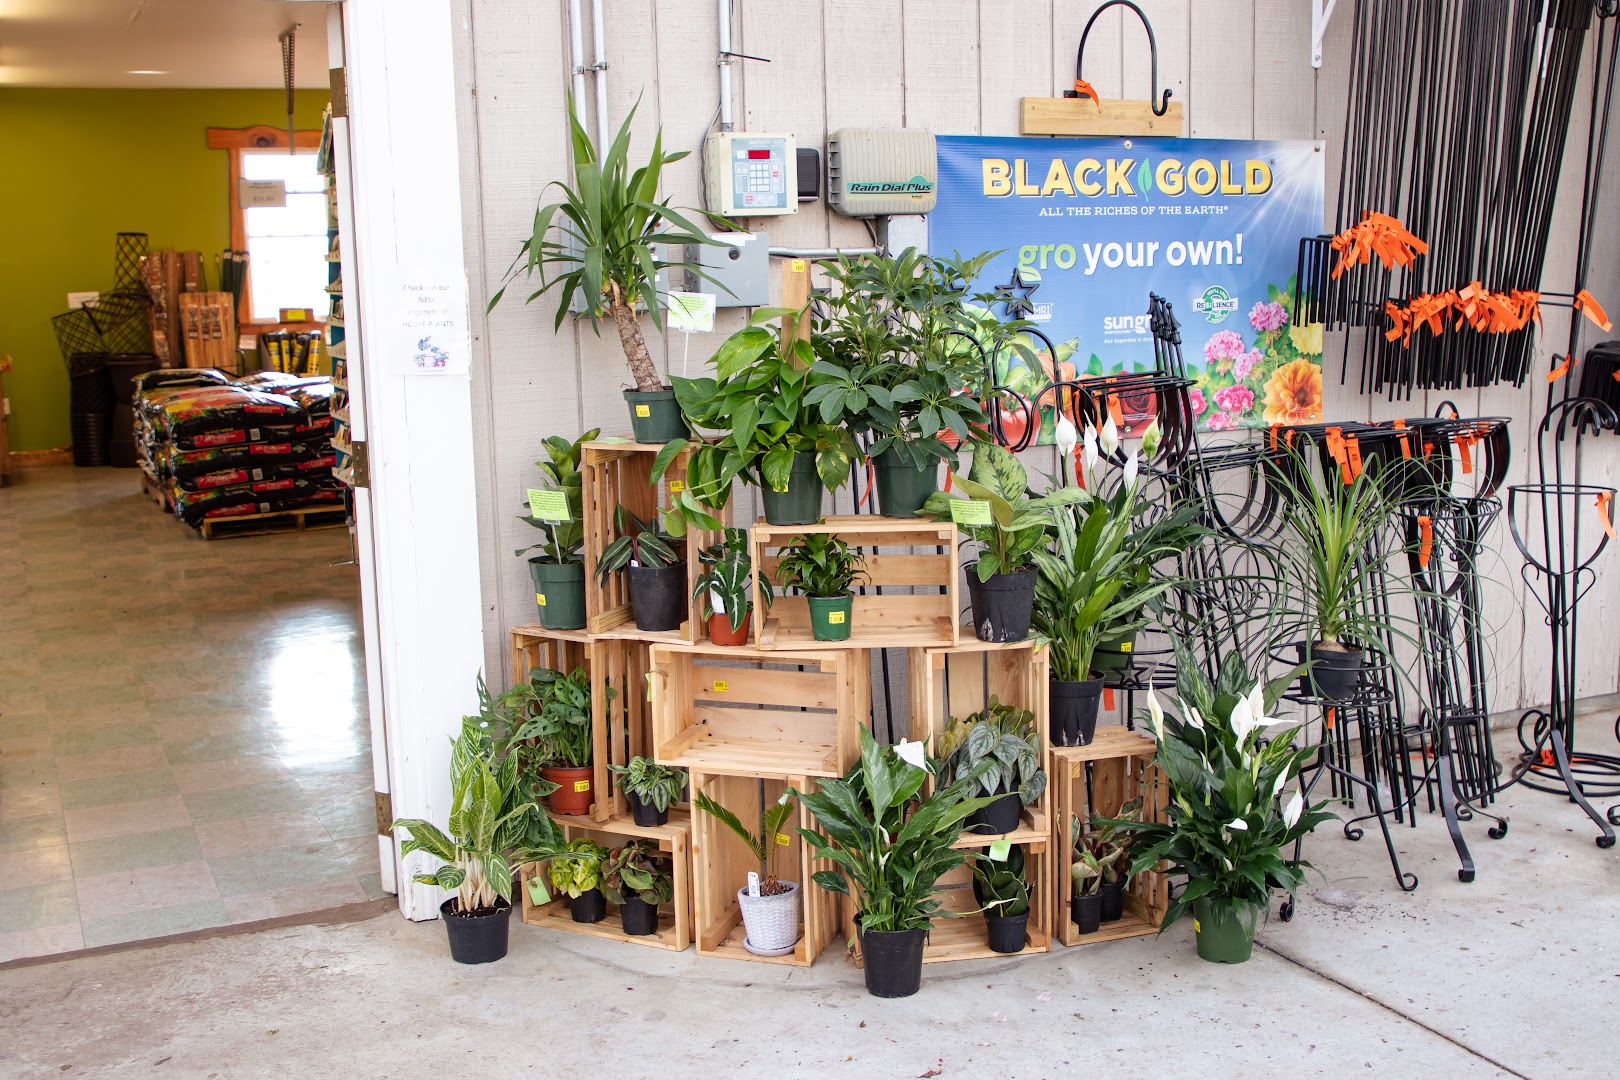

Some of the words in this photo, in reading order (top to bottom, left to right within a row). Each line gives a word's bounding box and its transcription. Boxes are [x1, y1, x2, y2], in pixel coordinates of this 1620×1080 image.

[982, 158, 1137, 198] BLACK
[1155, 158, 1275, 197] GOLD
[851, 183, 880, 192] Rain
[881, 183, 905, 192] Dial
[907, 183, 932, 191] Plus
[1039, 207, 1064, 217] ALL
[1067, 207, 1092, 216] THE
[1094, 206, 1138, 216] RICHES
[1140, 206, 1156, 215] OF
[1158, 206, 1182, 215] THE
[1017, 243, 1077, 282] gro
[1082, 241, 1160, 276] your
[1166, 233, 1244, 267] own!
[402, 284, 424, 292] Check
[1103, 314, 1153, 334] sungr
